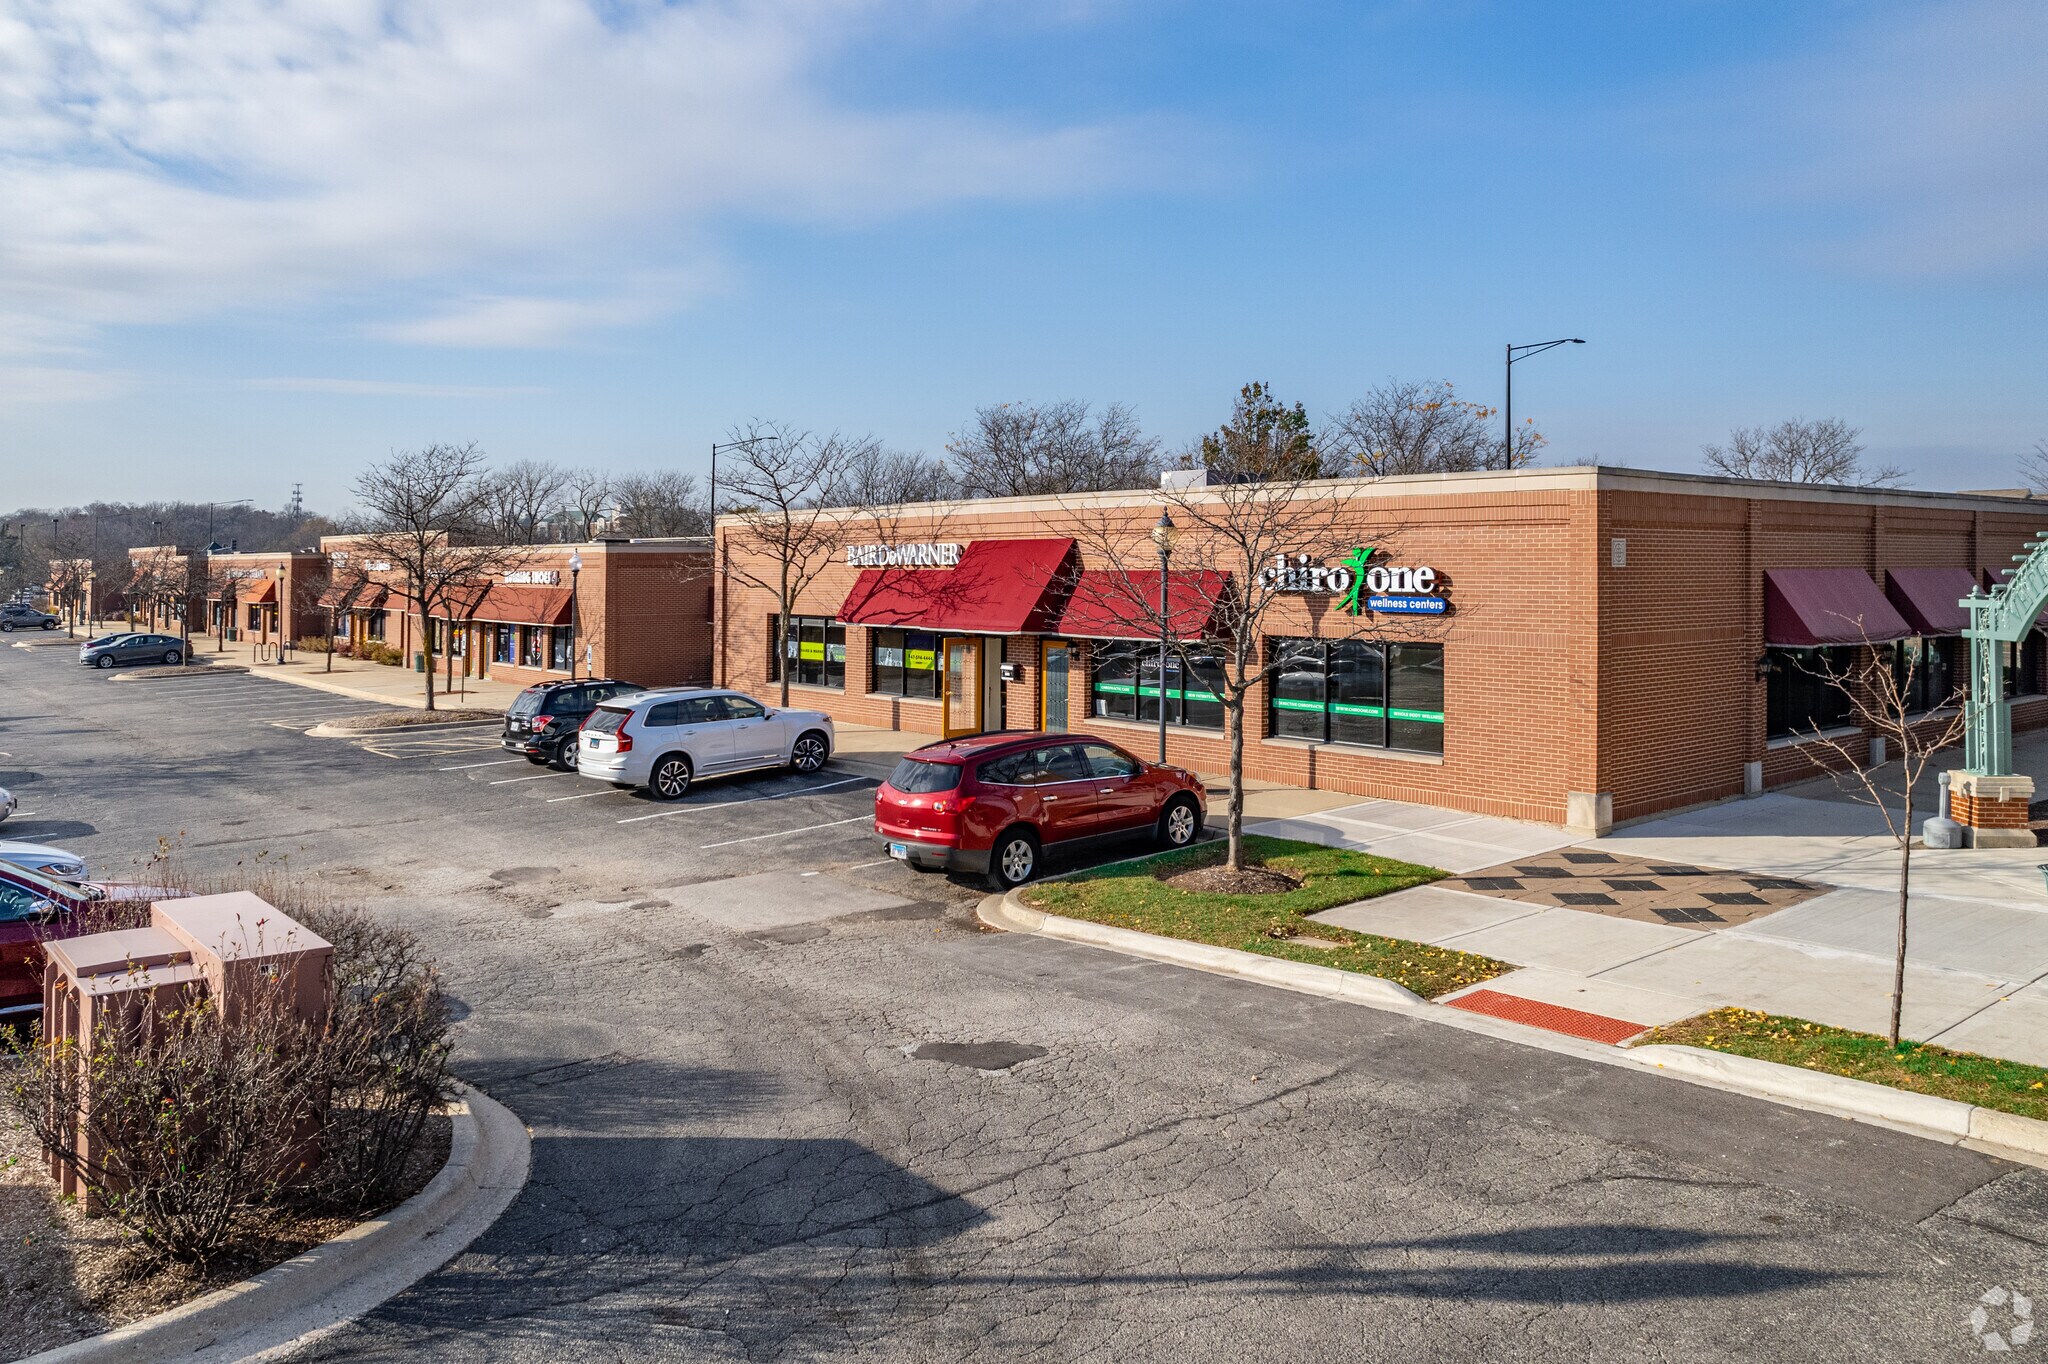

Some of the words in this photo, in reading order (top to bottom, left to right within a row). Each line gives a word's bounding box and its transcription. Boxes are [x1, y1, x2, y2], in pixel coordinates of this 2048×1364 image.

[1258, 554, 1350, 593] chiro
[1366, 566, 1435, 593] one
[1370, 598, 1407, 609] wellness
[1409, 600, 1443, 610] centers
